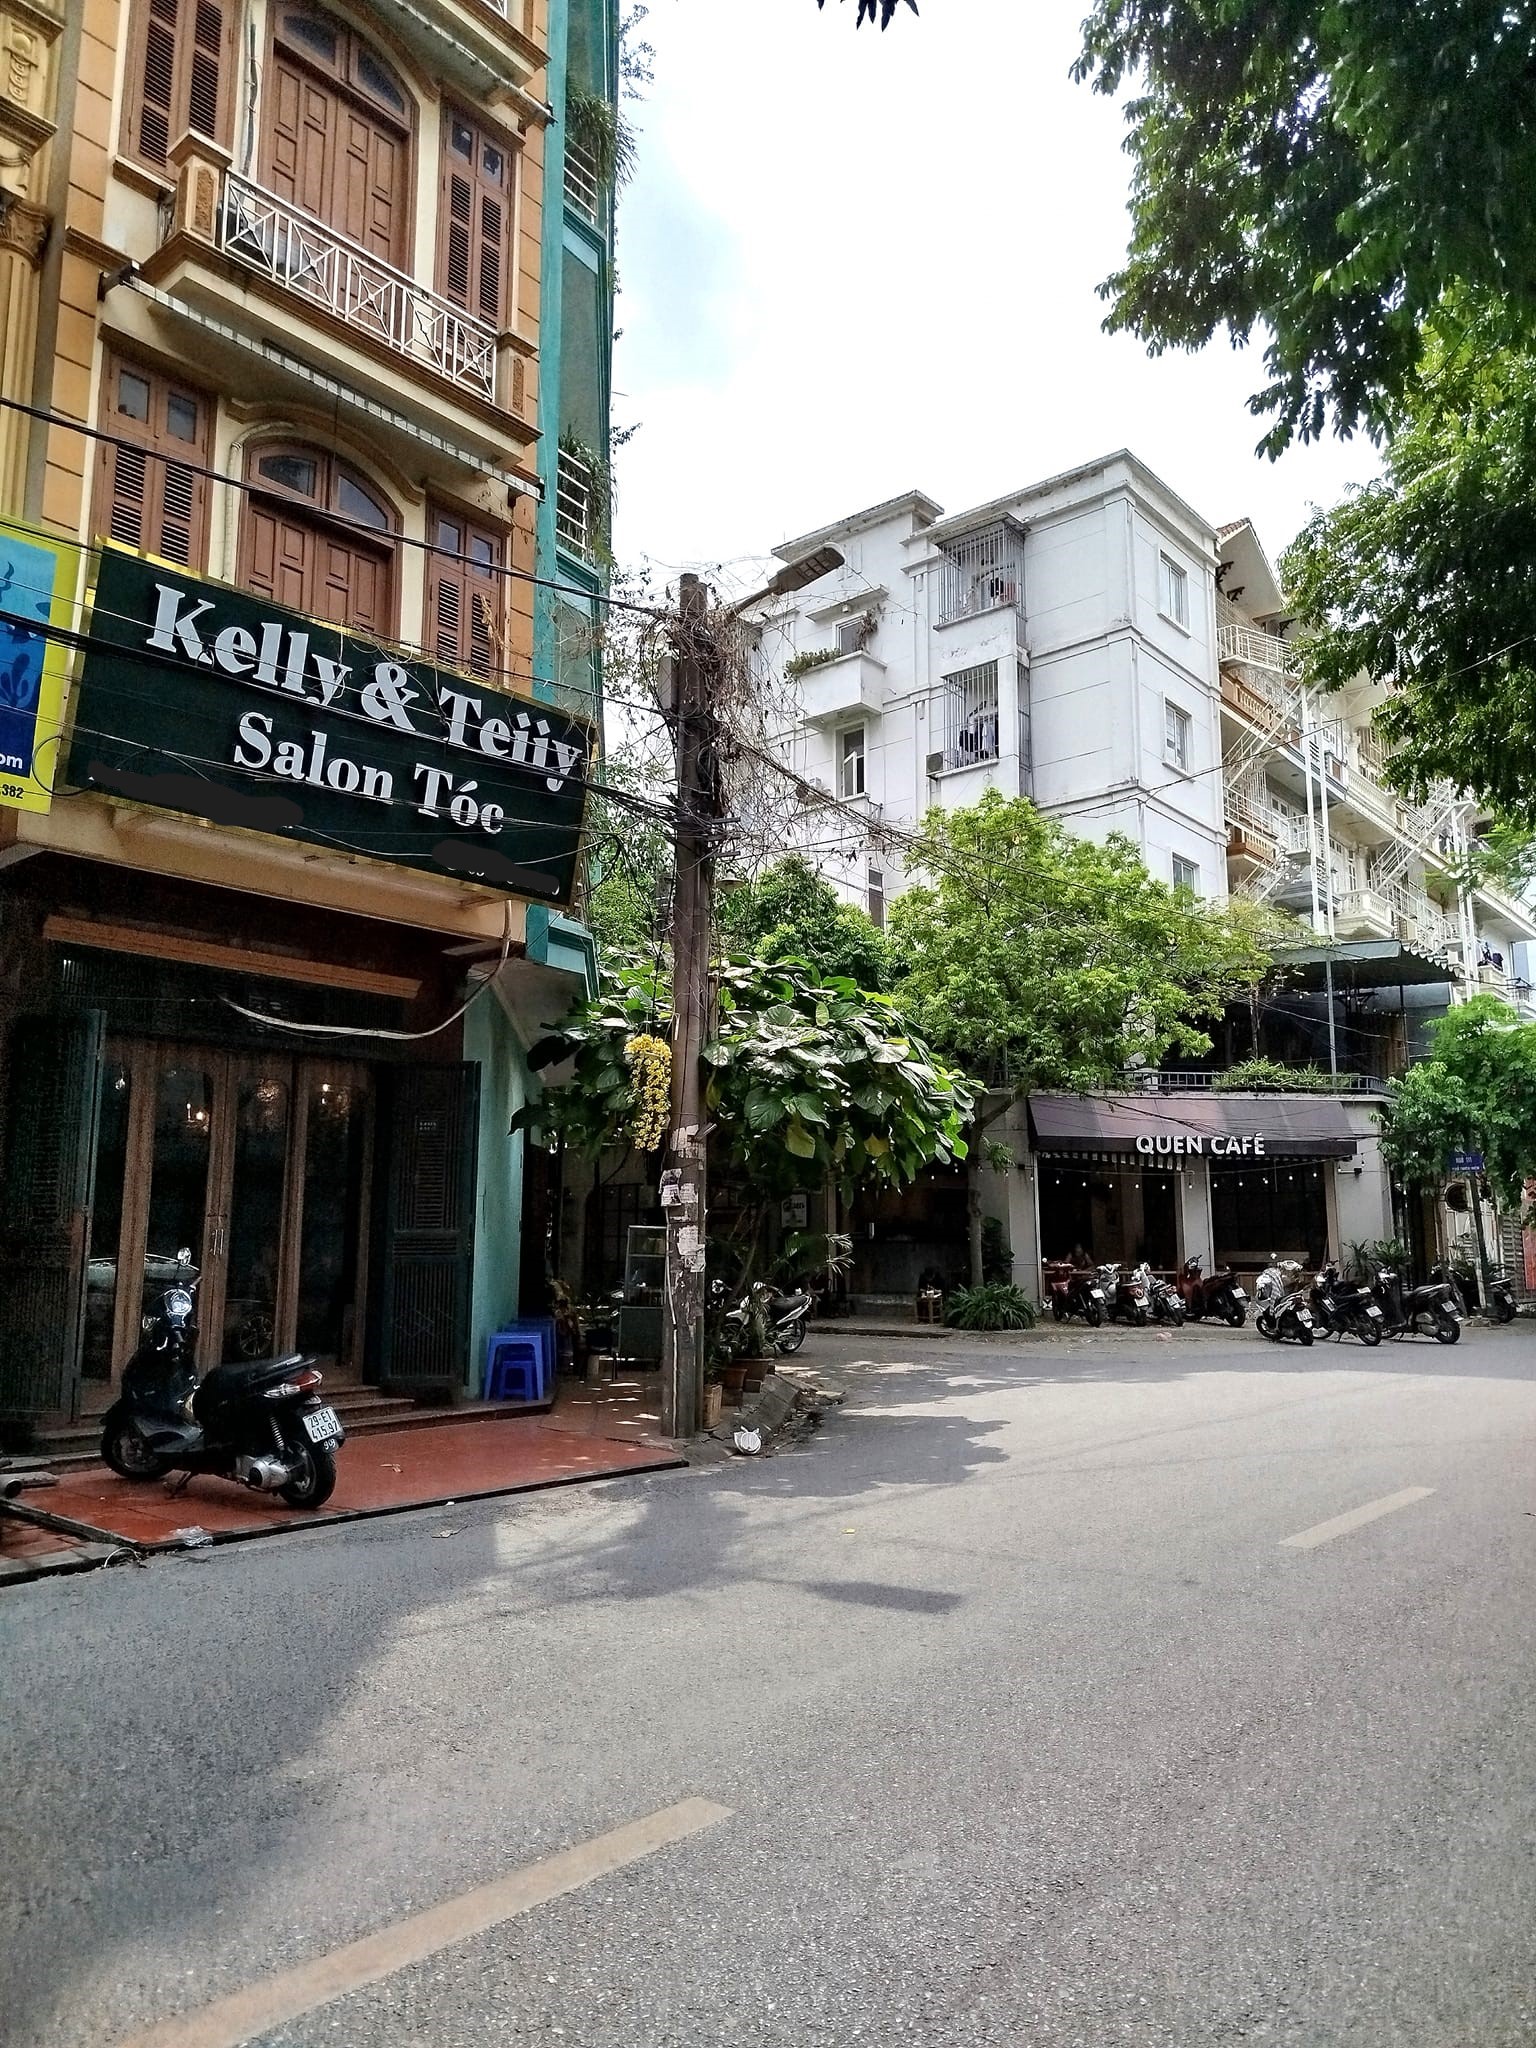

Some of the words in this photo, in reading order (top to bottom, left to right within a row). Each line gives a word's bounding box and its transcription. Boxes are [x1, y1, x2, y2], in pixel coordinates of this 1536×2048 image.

[146, 583, 353, 706] Kelly
[361, 662, 419, 732] &
[2, 784, 24, 799] 382
[234, 711, 393, 805] Salon
[414, 762, 504, 834] Tóc
[1136, 1135, 1203, 1155] QUEN
[1210, 1132, 1265, 1155] CAFÉ
